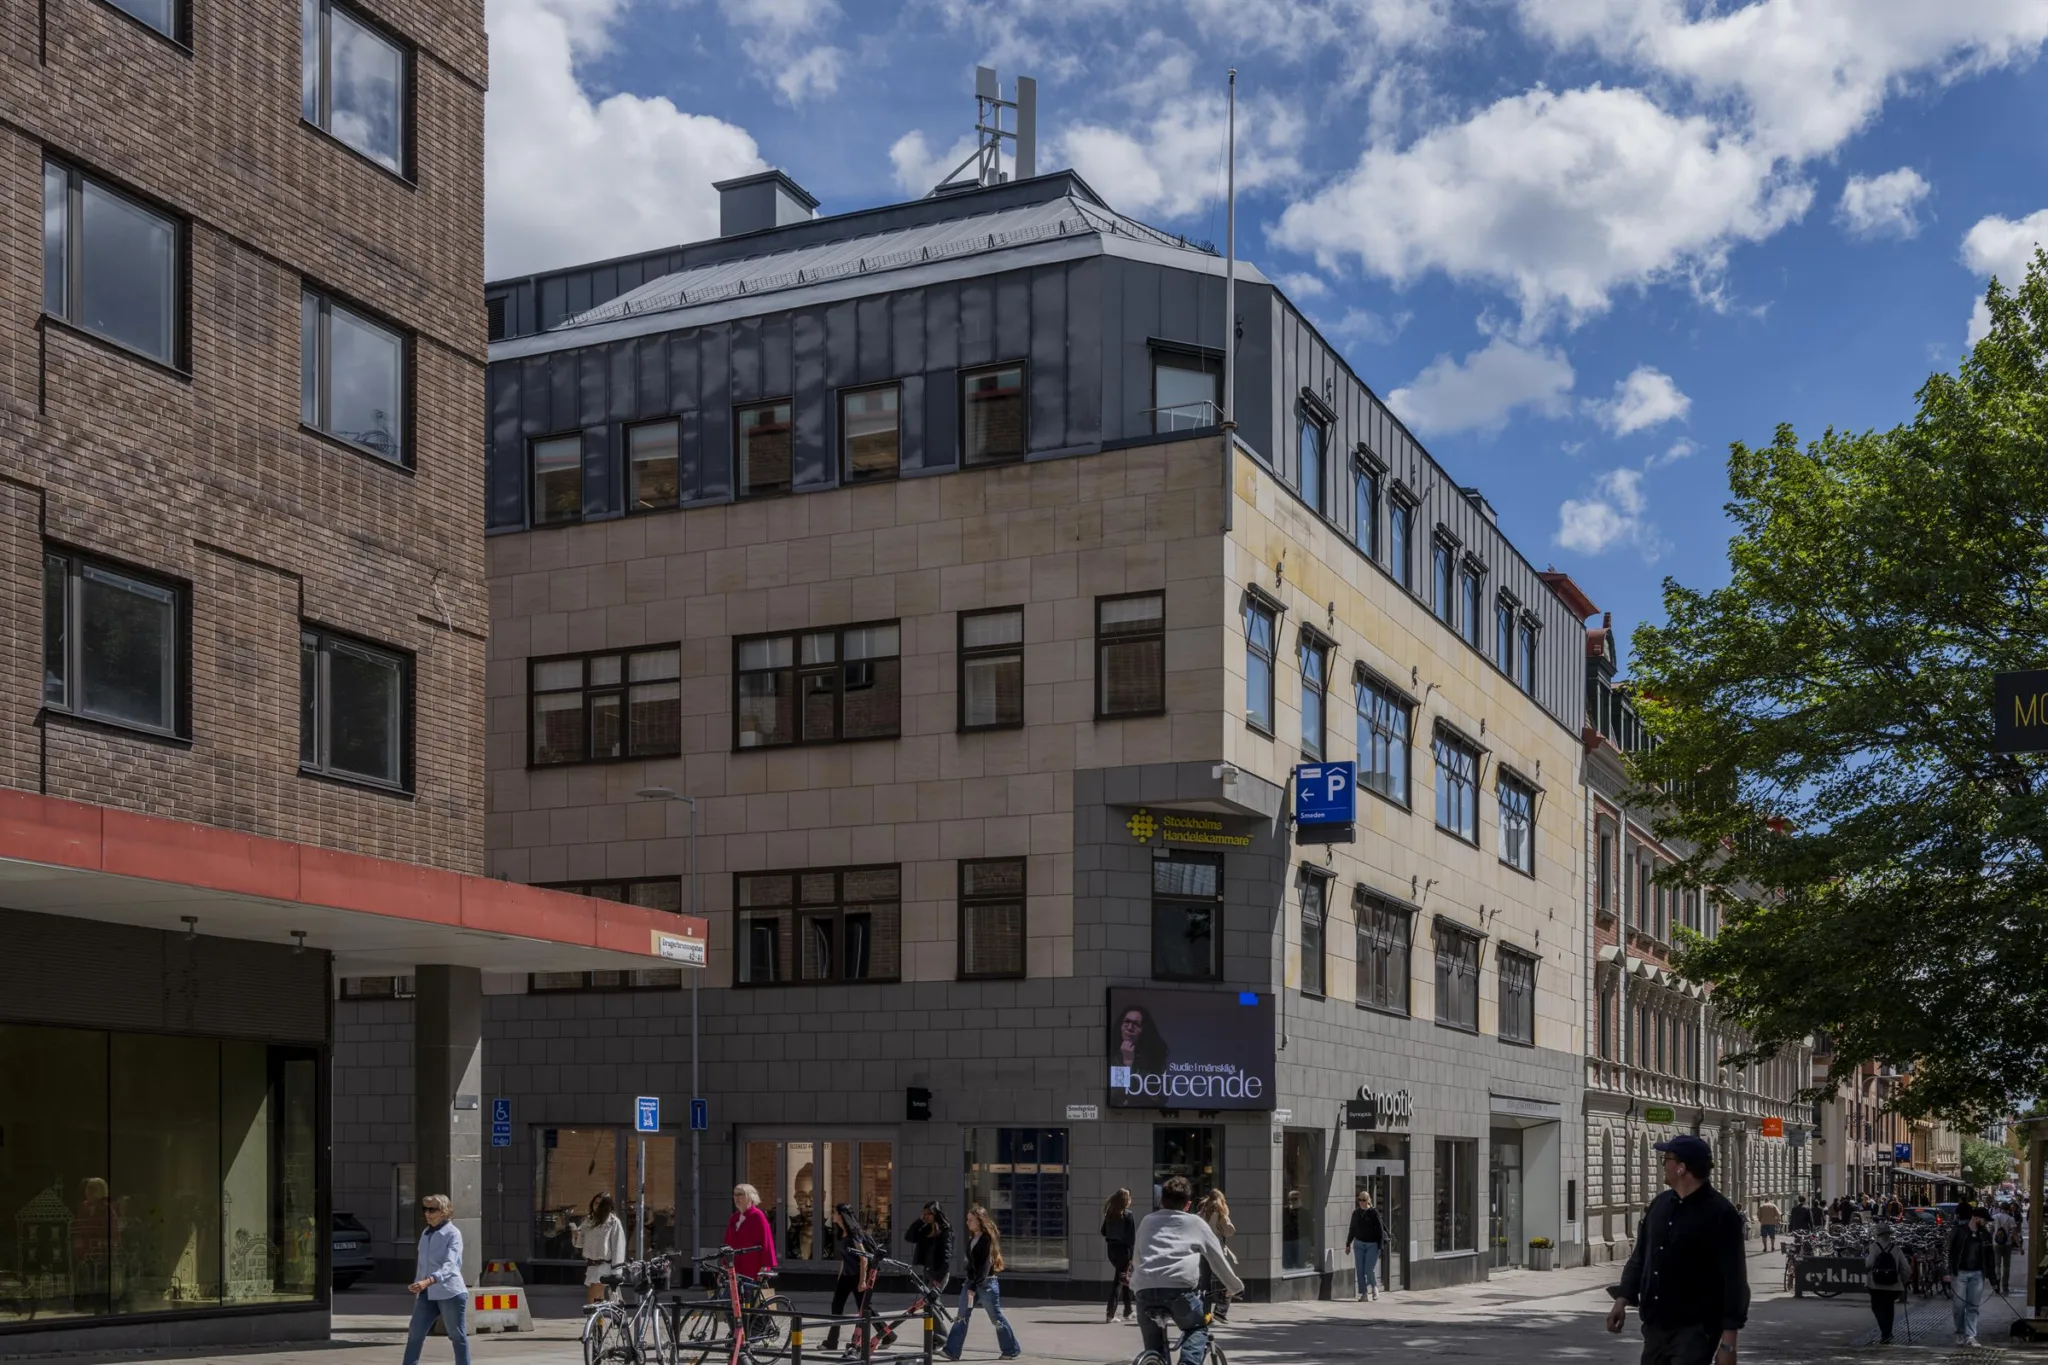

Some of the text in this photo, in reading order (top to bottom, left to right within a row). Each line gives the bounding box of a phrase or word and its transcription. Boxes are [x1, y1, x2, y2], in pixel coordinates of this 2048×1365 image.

[1327, 775, 1346, 802] P
[1163, 815, 1223, 831] Stockholms
[1300, 811, 1325, 819] Smeden
[1163, 829, 1249, 846] Handelskammare
[1169, 1062, 1193, 1072] Studie
[1198, 1063, 1236, 1075] mänskligt
[1124, 1069, 1263, 1098] beteende
[1361, 1084, 1414, 1125] Snoptik
